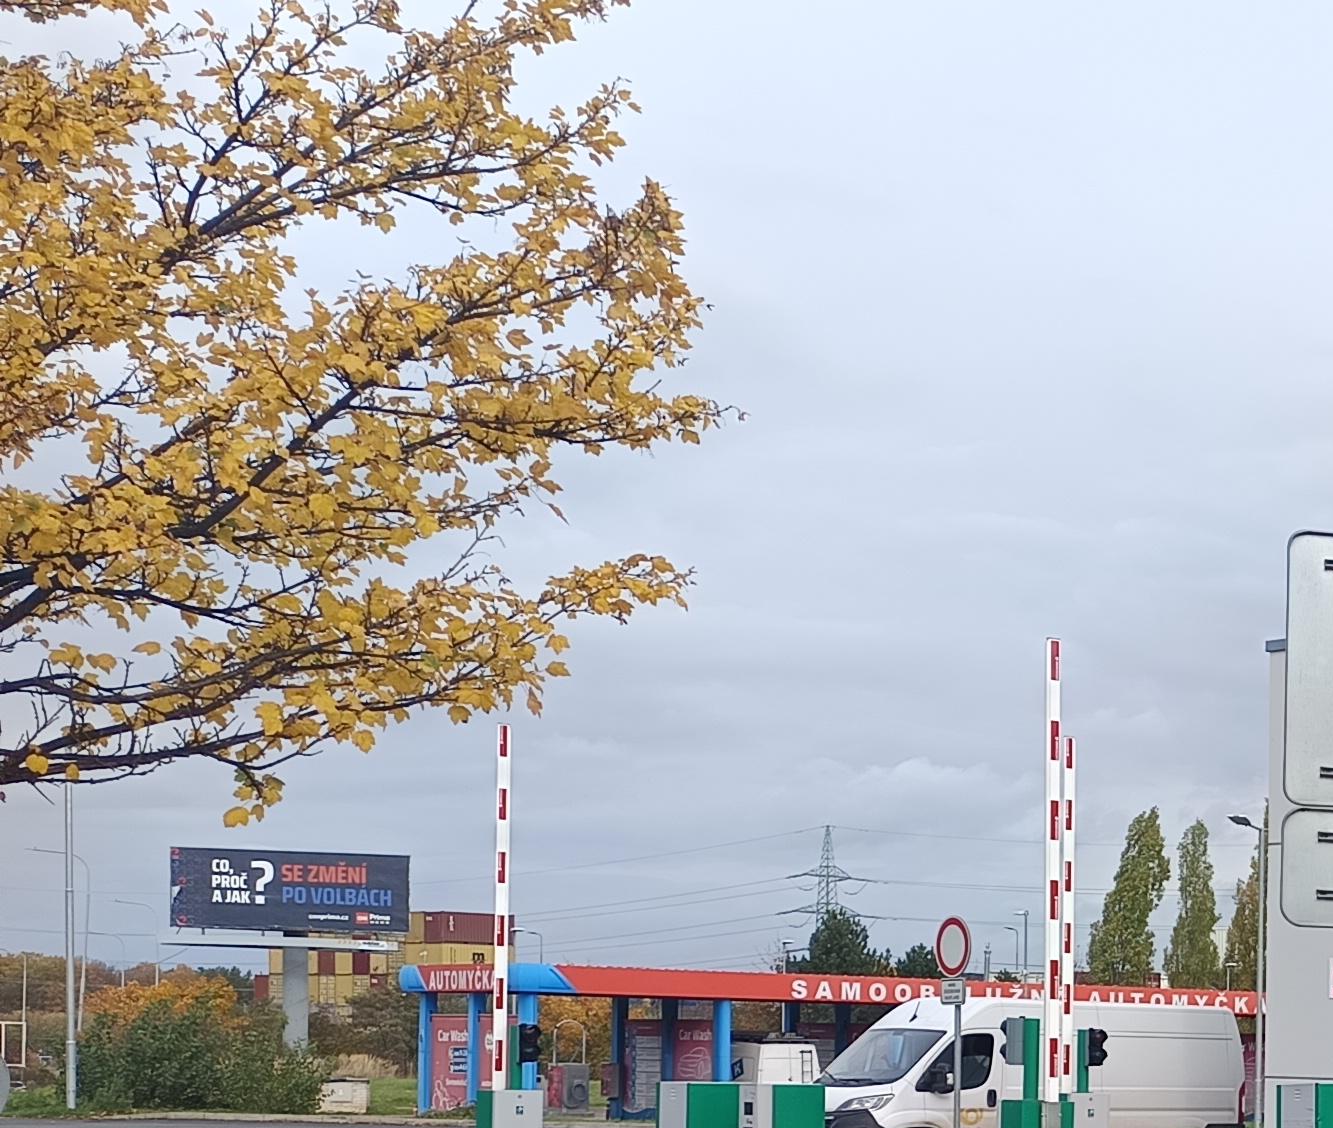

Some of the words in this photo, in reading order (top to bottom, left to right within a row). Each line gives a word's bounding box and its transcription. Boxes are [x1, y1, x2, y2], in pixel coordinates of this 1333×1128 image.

[211, 859, 234, 875] CO,
[281, 864, 303, 882] SE
[306, 861, 368, 885] ZMĚNÍ
[211, 872, 249, 889] PROČ
[250, 860, 275, 905] ?
[211, 891, 223, 903] A
[224, 890, 251, 904] JAK
[281, 886, 306, 904] PO
[310, 884, 392, 907] VOLBÁCH
[437, 1030, 449, 1042] Car
[679, 1028, 691, 1041] Car
[692, 1029, 712, 1041] Wash
